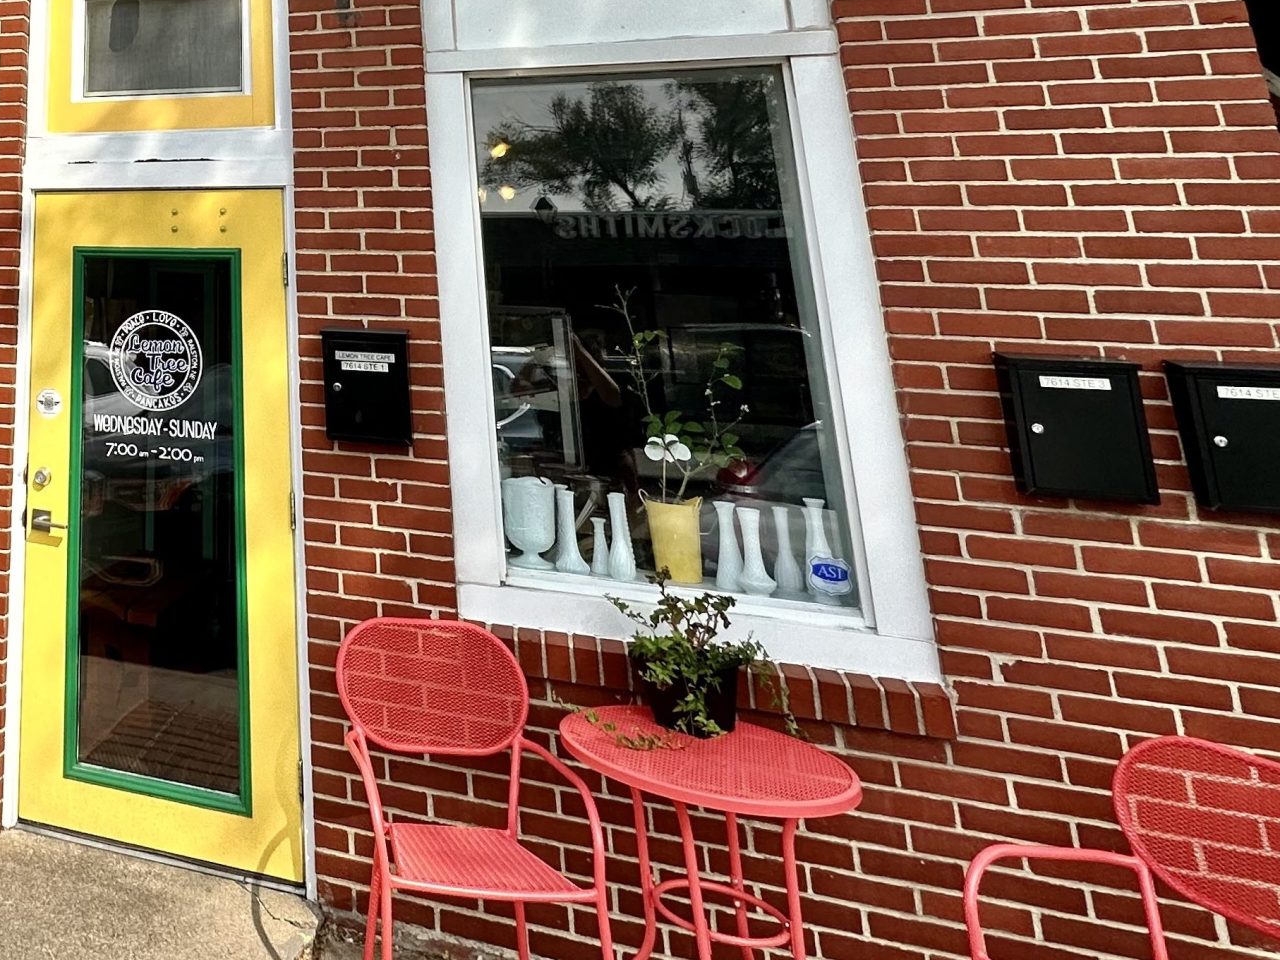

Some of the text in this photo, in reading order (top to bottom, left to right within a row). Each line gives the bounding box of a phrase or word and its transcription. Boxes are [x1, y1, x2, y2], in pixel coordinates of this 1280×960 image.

[127, 333, 185, 354] Lemon
[146, 353, 190, 373] Tree
[130, 367, 174, 392] Cafe
[1043, 377, 1070, 387] 7614
[1072, 378, 1097, 388] STE
[1224, 387, 1252, 397] 7614
